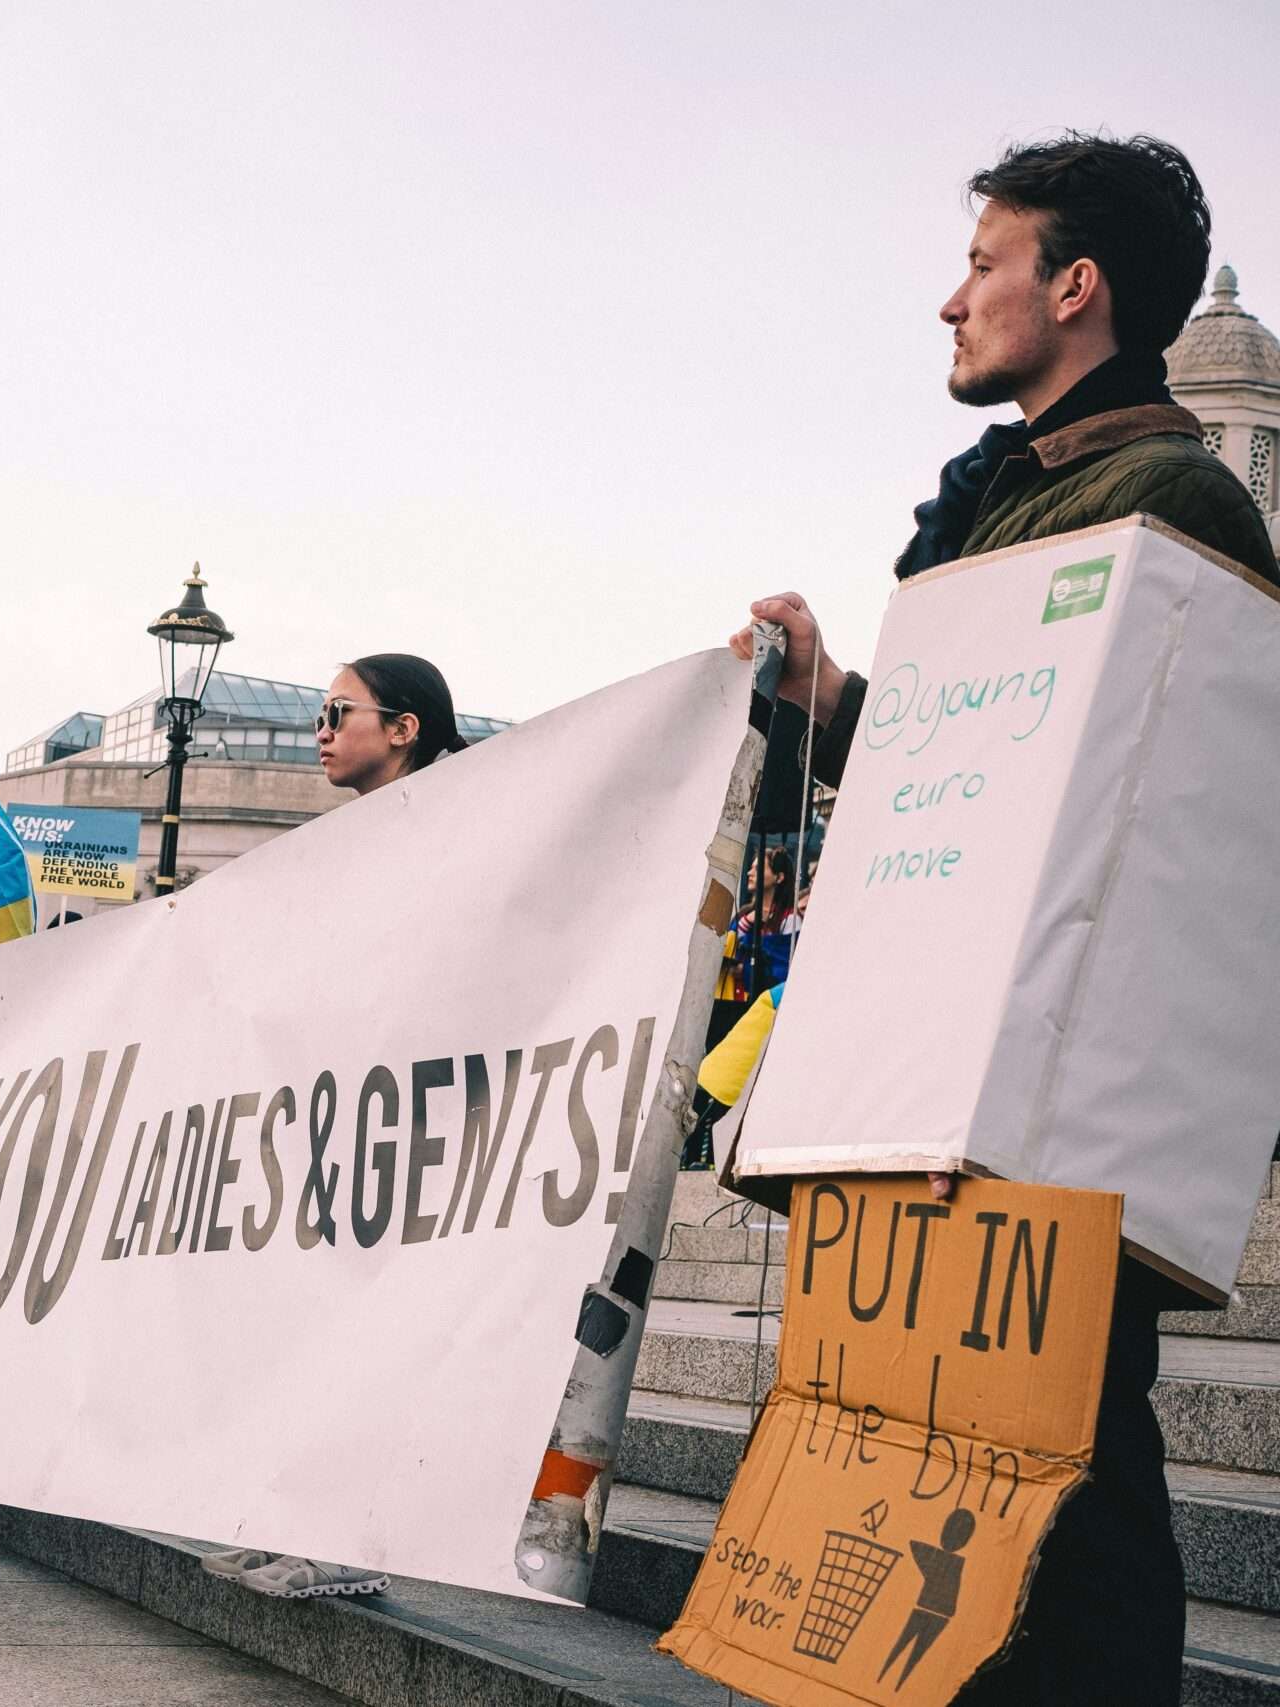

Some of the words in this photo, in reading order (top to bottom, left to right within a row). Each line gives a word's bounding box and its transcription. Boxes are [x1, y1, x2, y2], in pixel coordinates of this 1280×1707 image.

[892, 770, 986, 813] euro
[12, 816, 75, 832] KNOW
[17, 829, 64, 843] THIS:
[43, 849, 71, 858] ARE
[74, 851, 105, 861] NOW
[44, 841, 128, 855] UKRAINIANS
[42, 857, 119, 871] DEFENDING
[864, 844, 963, 889] move
[41, 866, 68, 876] THE
[72, 868, 119, 880] WHOLE
[40, 875, 73, 885] FREE
[78, 878, 125, 889] WORLD
[101, 1085, 297, 1261] LADIES
[350, 1016, 657, 1249] GENTS!
[800, 1182, 951, 1330] PUT
[959, 1211, 1059, 1356] IN
[805, 1339, 886, 1471] the
[909, 1354, 1021, 1518] bin
[768, 1560, 802, 1600] the
